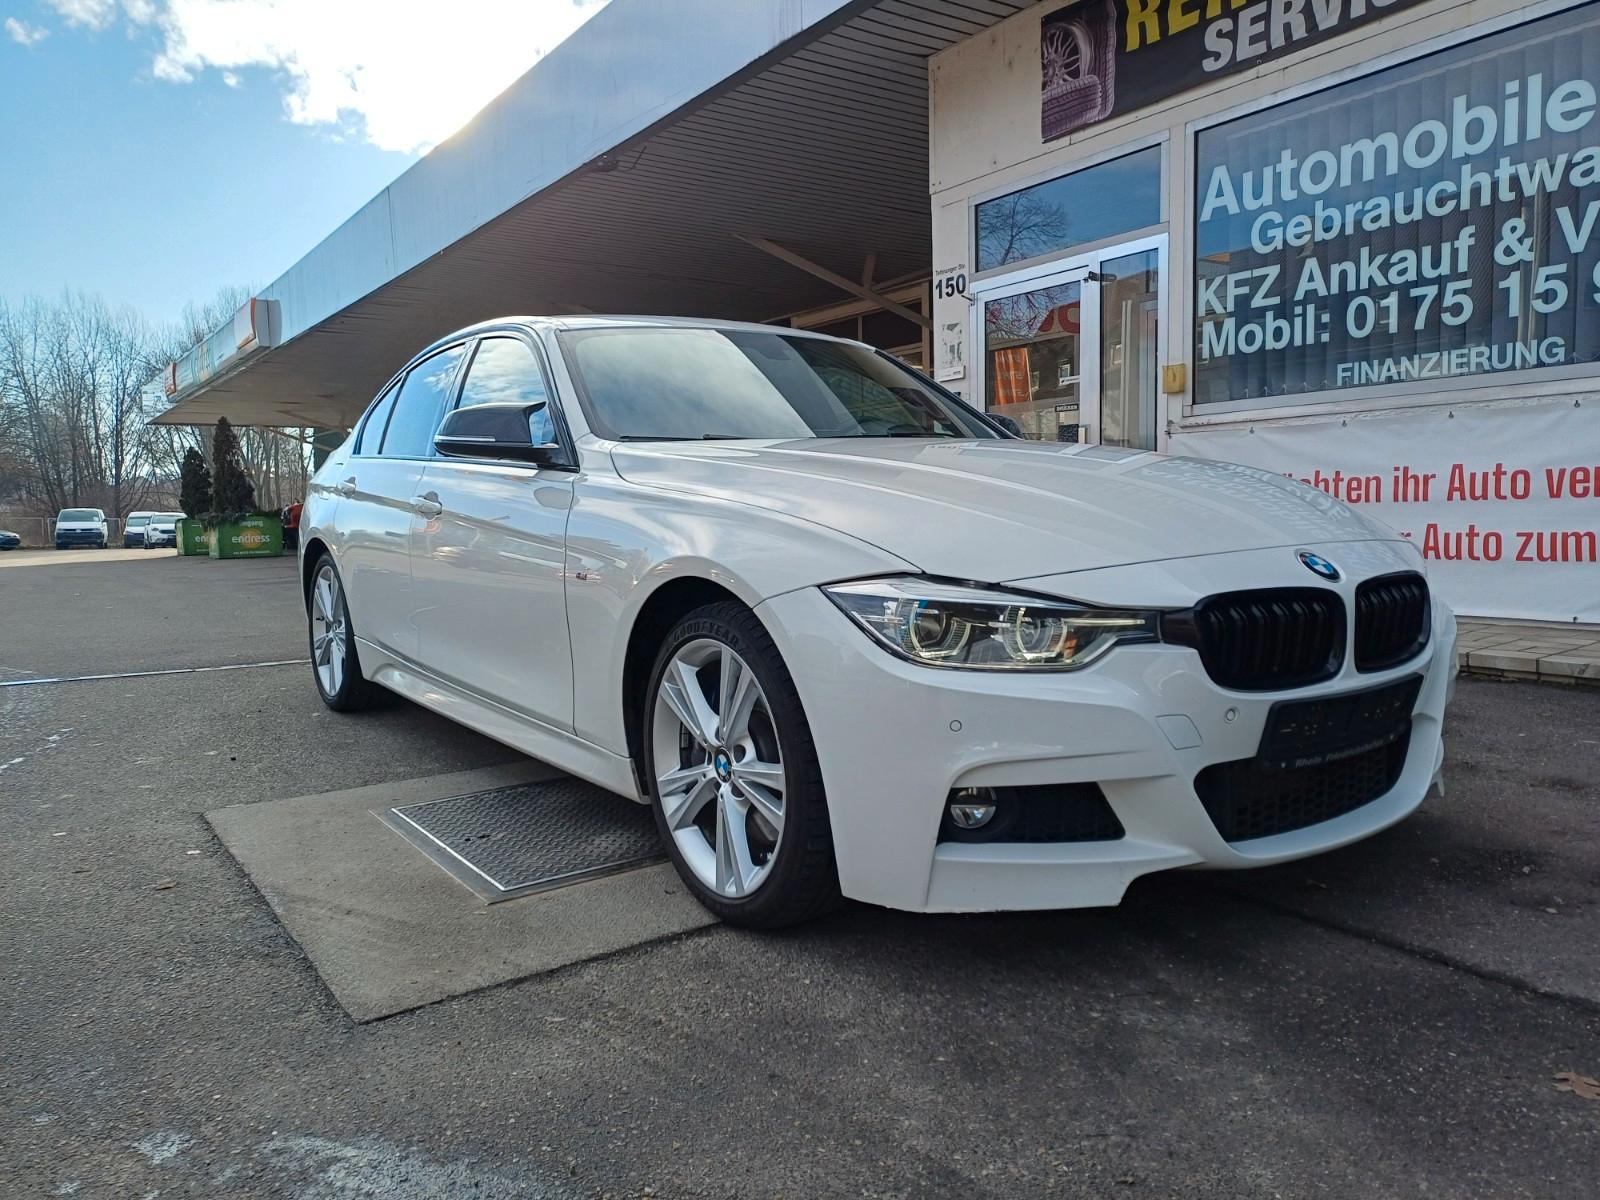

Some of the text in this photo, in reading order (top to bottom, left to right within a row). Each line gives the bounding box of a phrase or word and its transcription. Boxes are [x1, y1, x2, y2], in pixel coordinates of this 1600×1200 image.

[1202, 0, 1398, 72] SERV
[1200, 73, 1597, 222] Automobile
[1250, 146, 1600, 254] Gebrauchtwa
[935, 273, 966, 299] 150
[1198, 199, 1600, 317] KFZ Ankauf & V
[1201, 304, 1330, 359] Mobil:
[1345, 278, 1473, 339] 0175
[1498, 263, 1568, 318] 15
[1336, 336, 1565, 387] FINANZIERUNG
[1281, 470, 1382, 504] hten
[1392, 466, 1437, 503] ihr
[1447, 463, 1531, 502] Auto
[231, 533, 270, 544] endress
[1423, 523, 1597, 563] Auto zum
